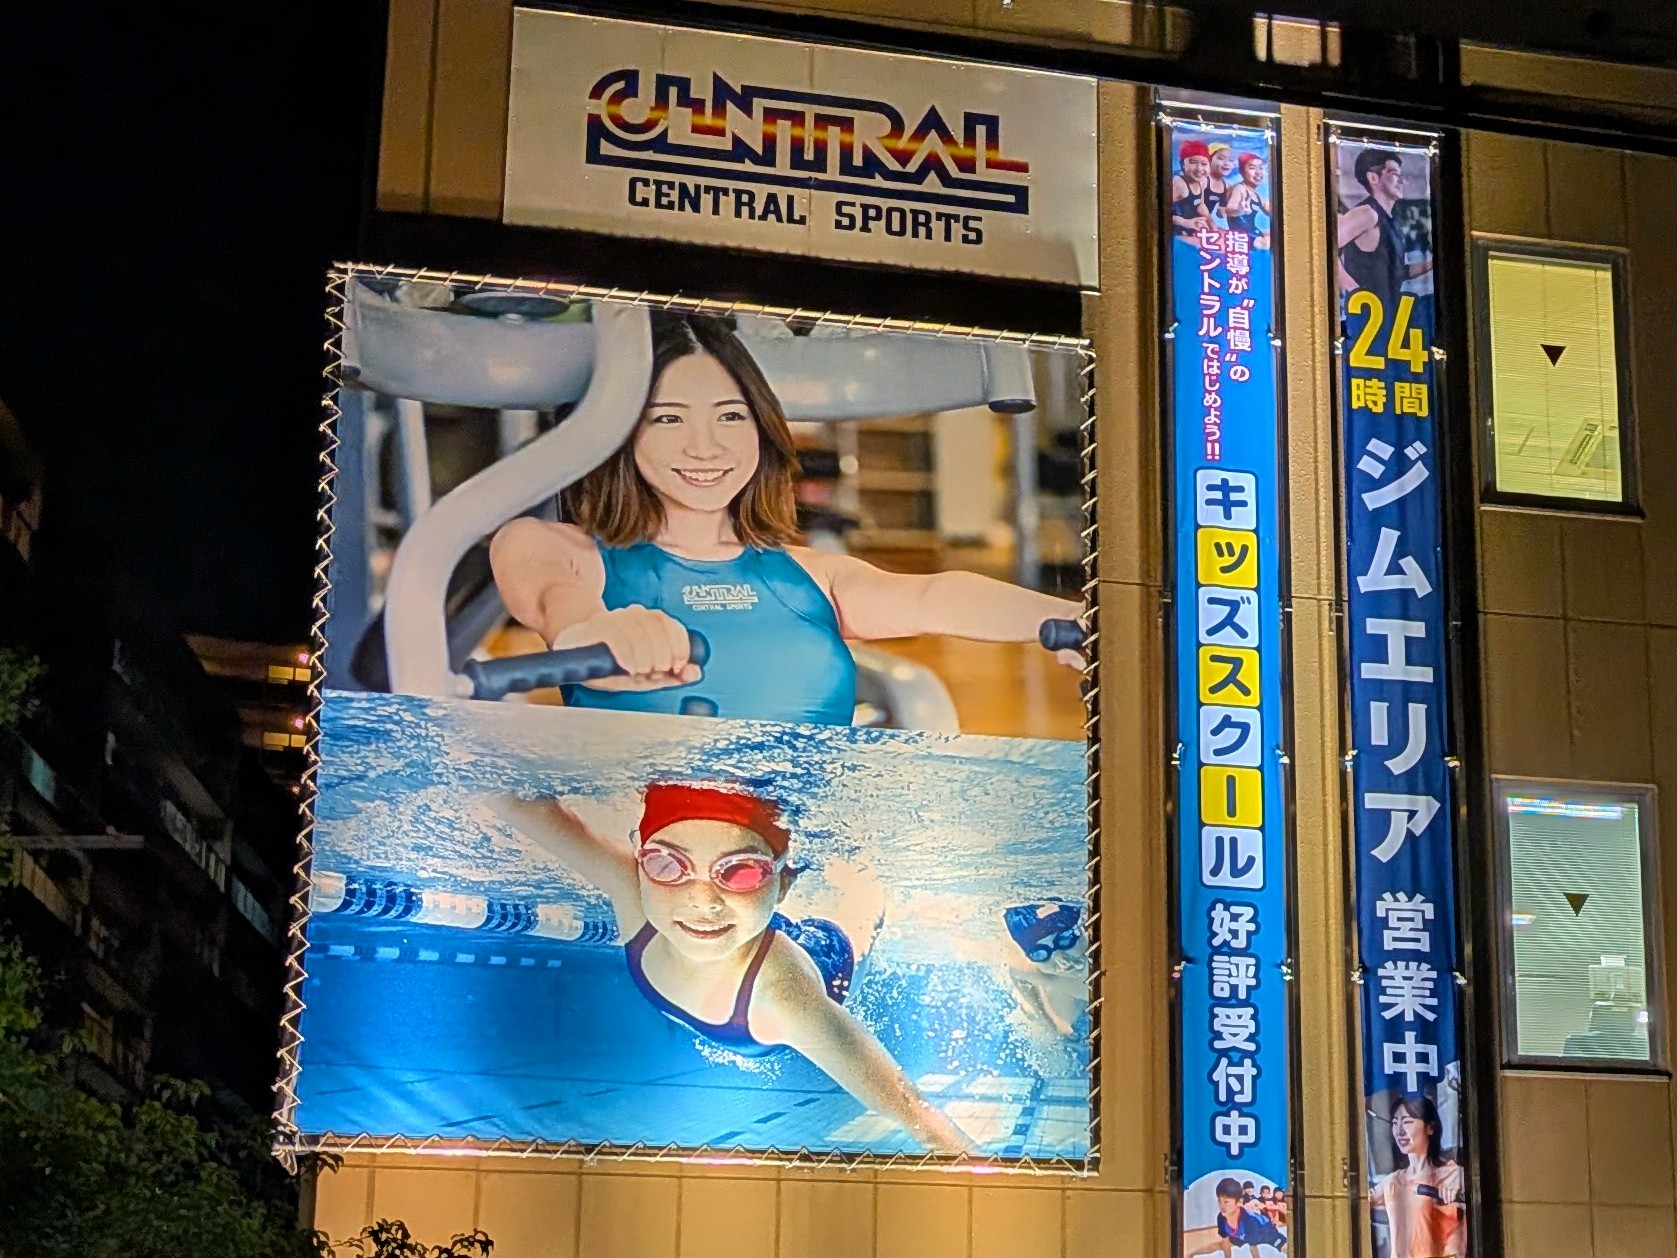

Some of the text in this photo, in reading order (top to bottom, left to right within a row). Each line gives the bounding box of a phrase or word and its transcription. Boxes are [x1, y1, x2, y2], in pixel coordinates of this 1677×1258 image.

[586, 68, 1030, 214] CENTRAL
[627, 176, 984, 245] CENTRAL SPORTS
[1347, 290, 1429, 373] 24
[1351, 378, 1430, 417] 時間
[1202, 475, 1259, 879] キッズスクール
[1211, 902, 1258, 1156] 好評受付中
